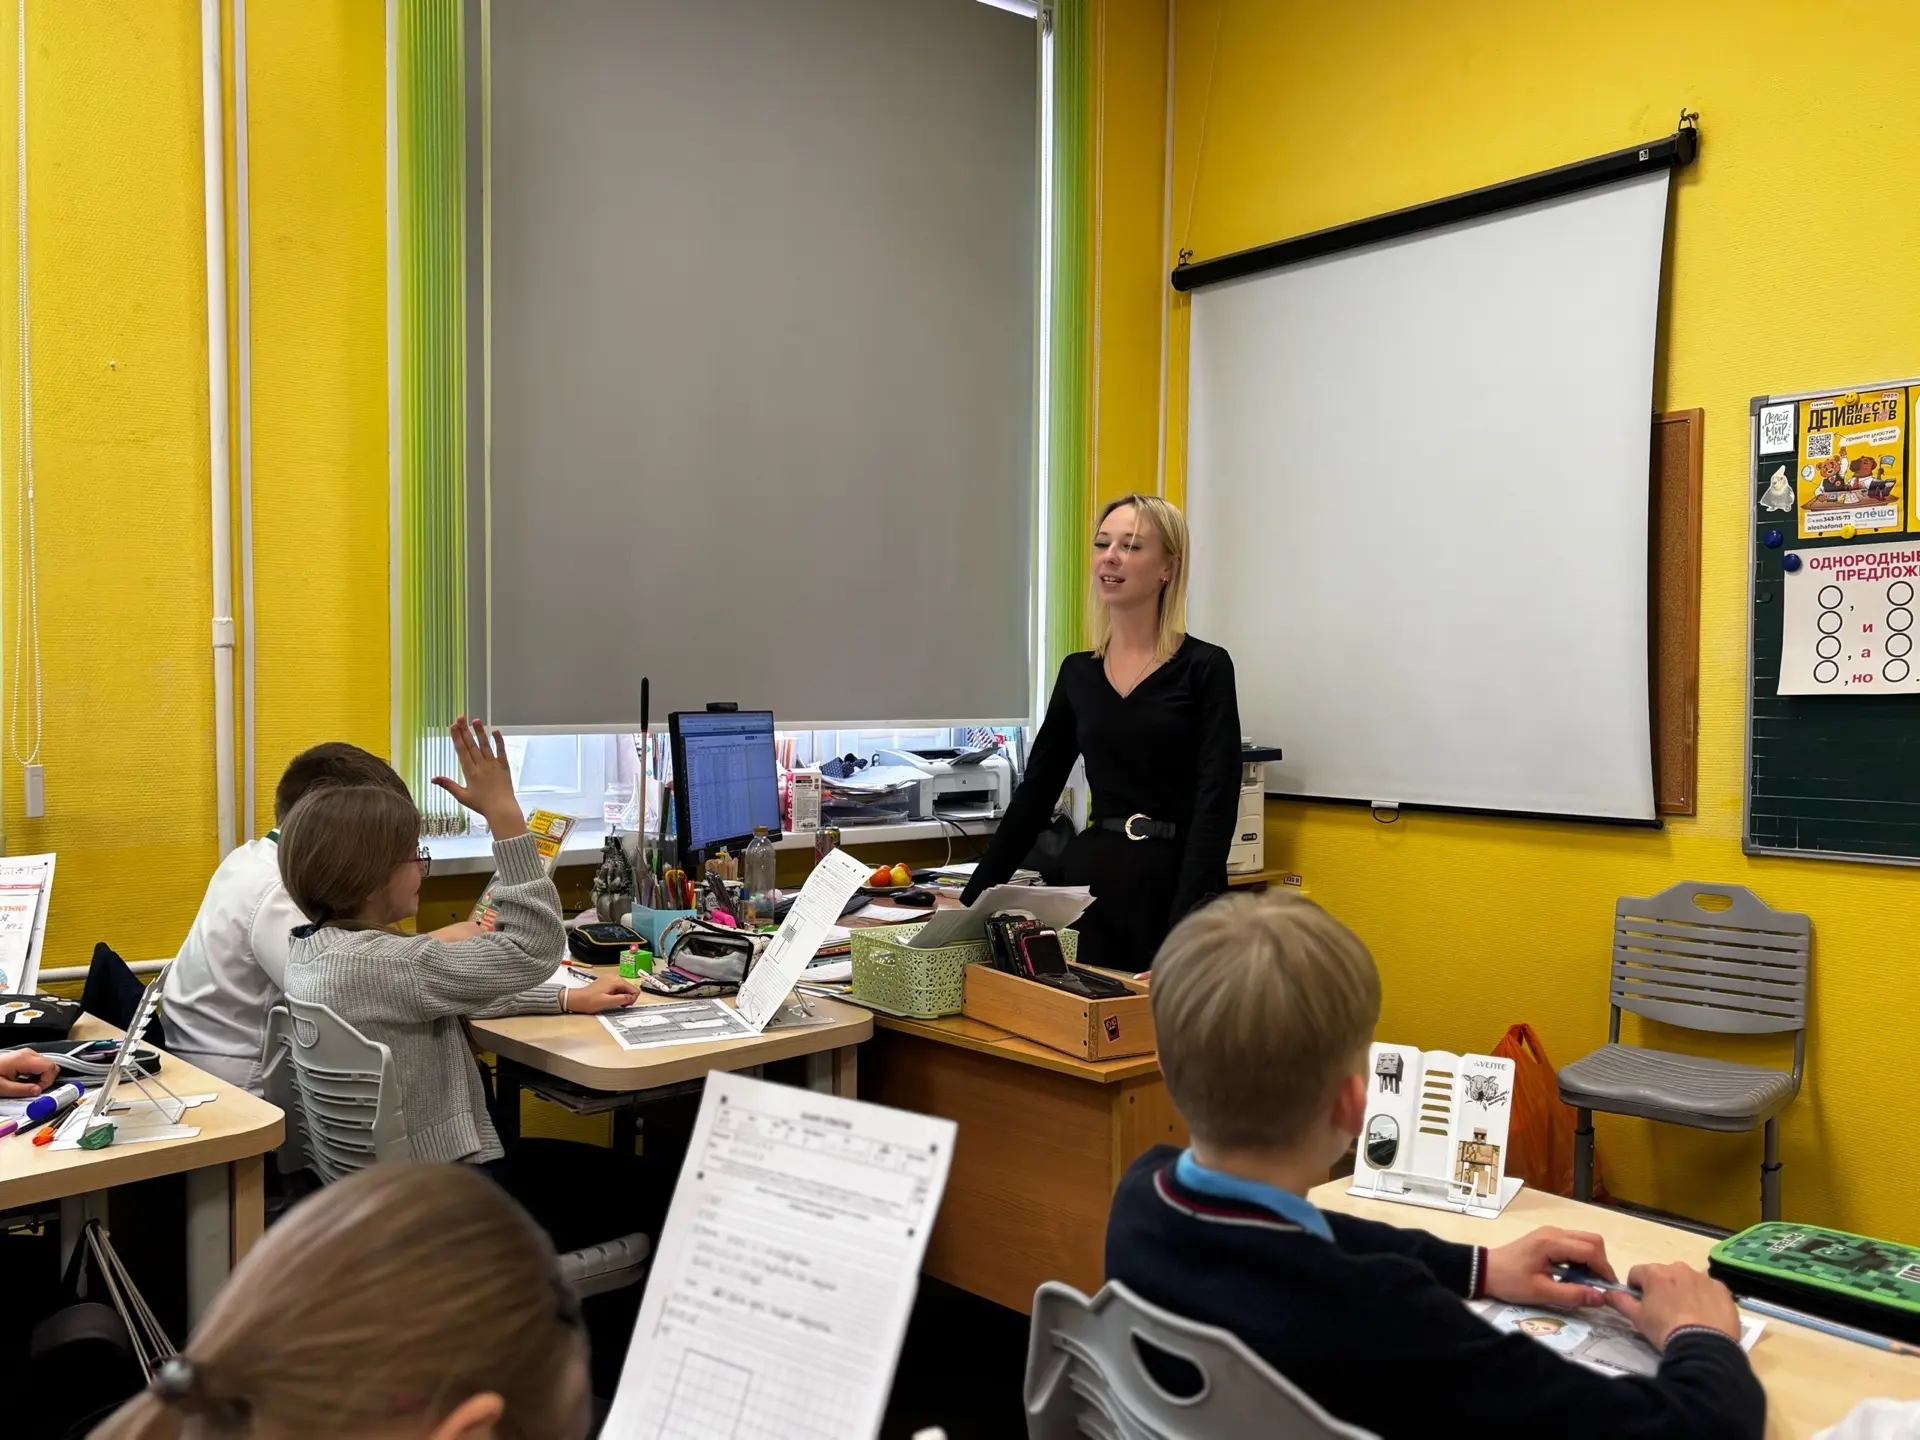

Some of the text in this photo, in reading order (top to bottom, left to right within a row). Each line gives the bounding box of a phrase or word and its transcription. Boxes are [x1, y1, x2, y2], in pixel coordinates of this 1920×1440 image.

[1847, 400, 1897, 415] ВМСТО
[1807, 406, 1846, 433] ДЕТИ
[1846, 410, 1897, 426] ЦВЕТВ
[1835, 565, 1920, 582] ПРЕДЛОЖ
[1862, 623, 1873, 633] и
[1861, 649, 1871, 658] а
